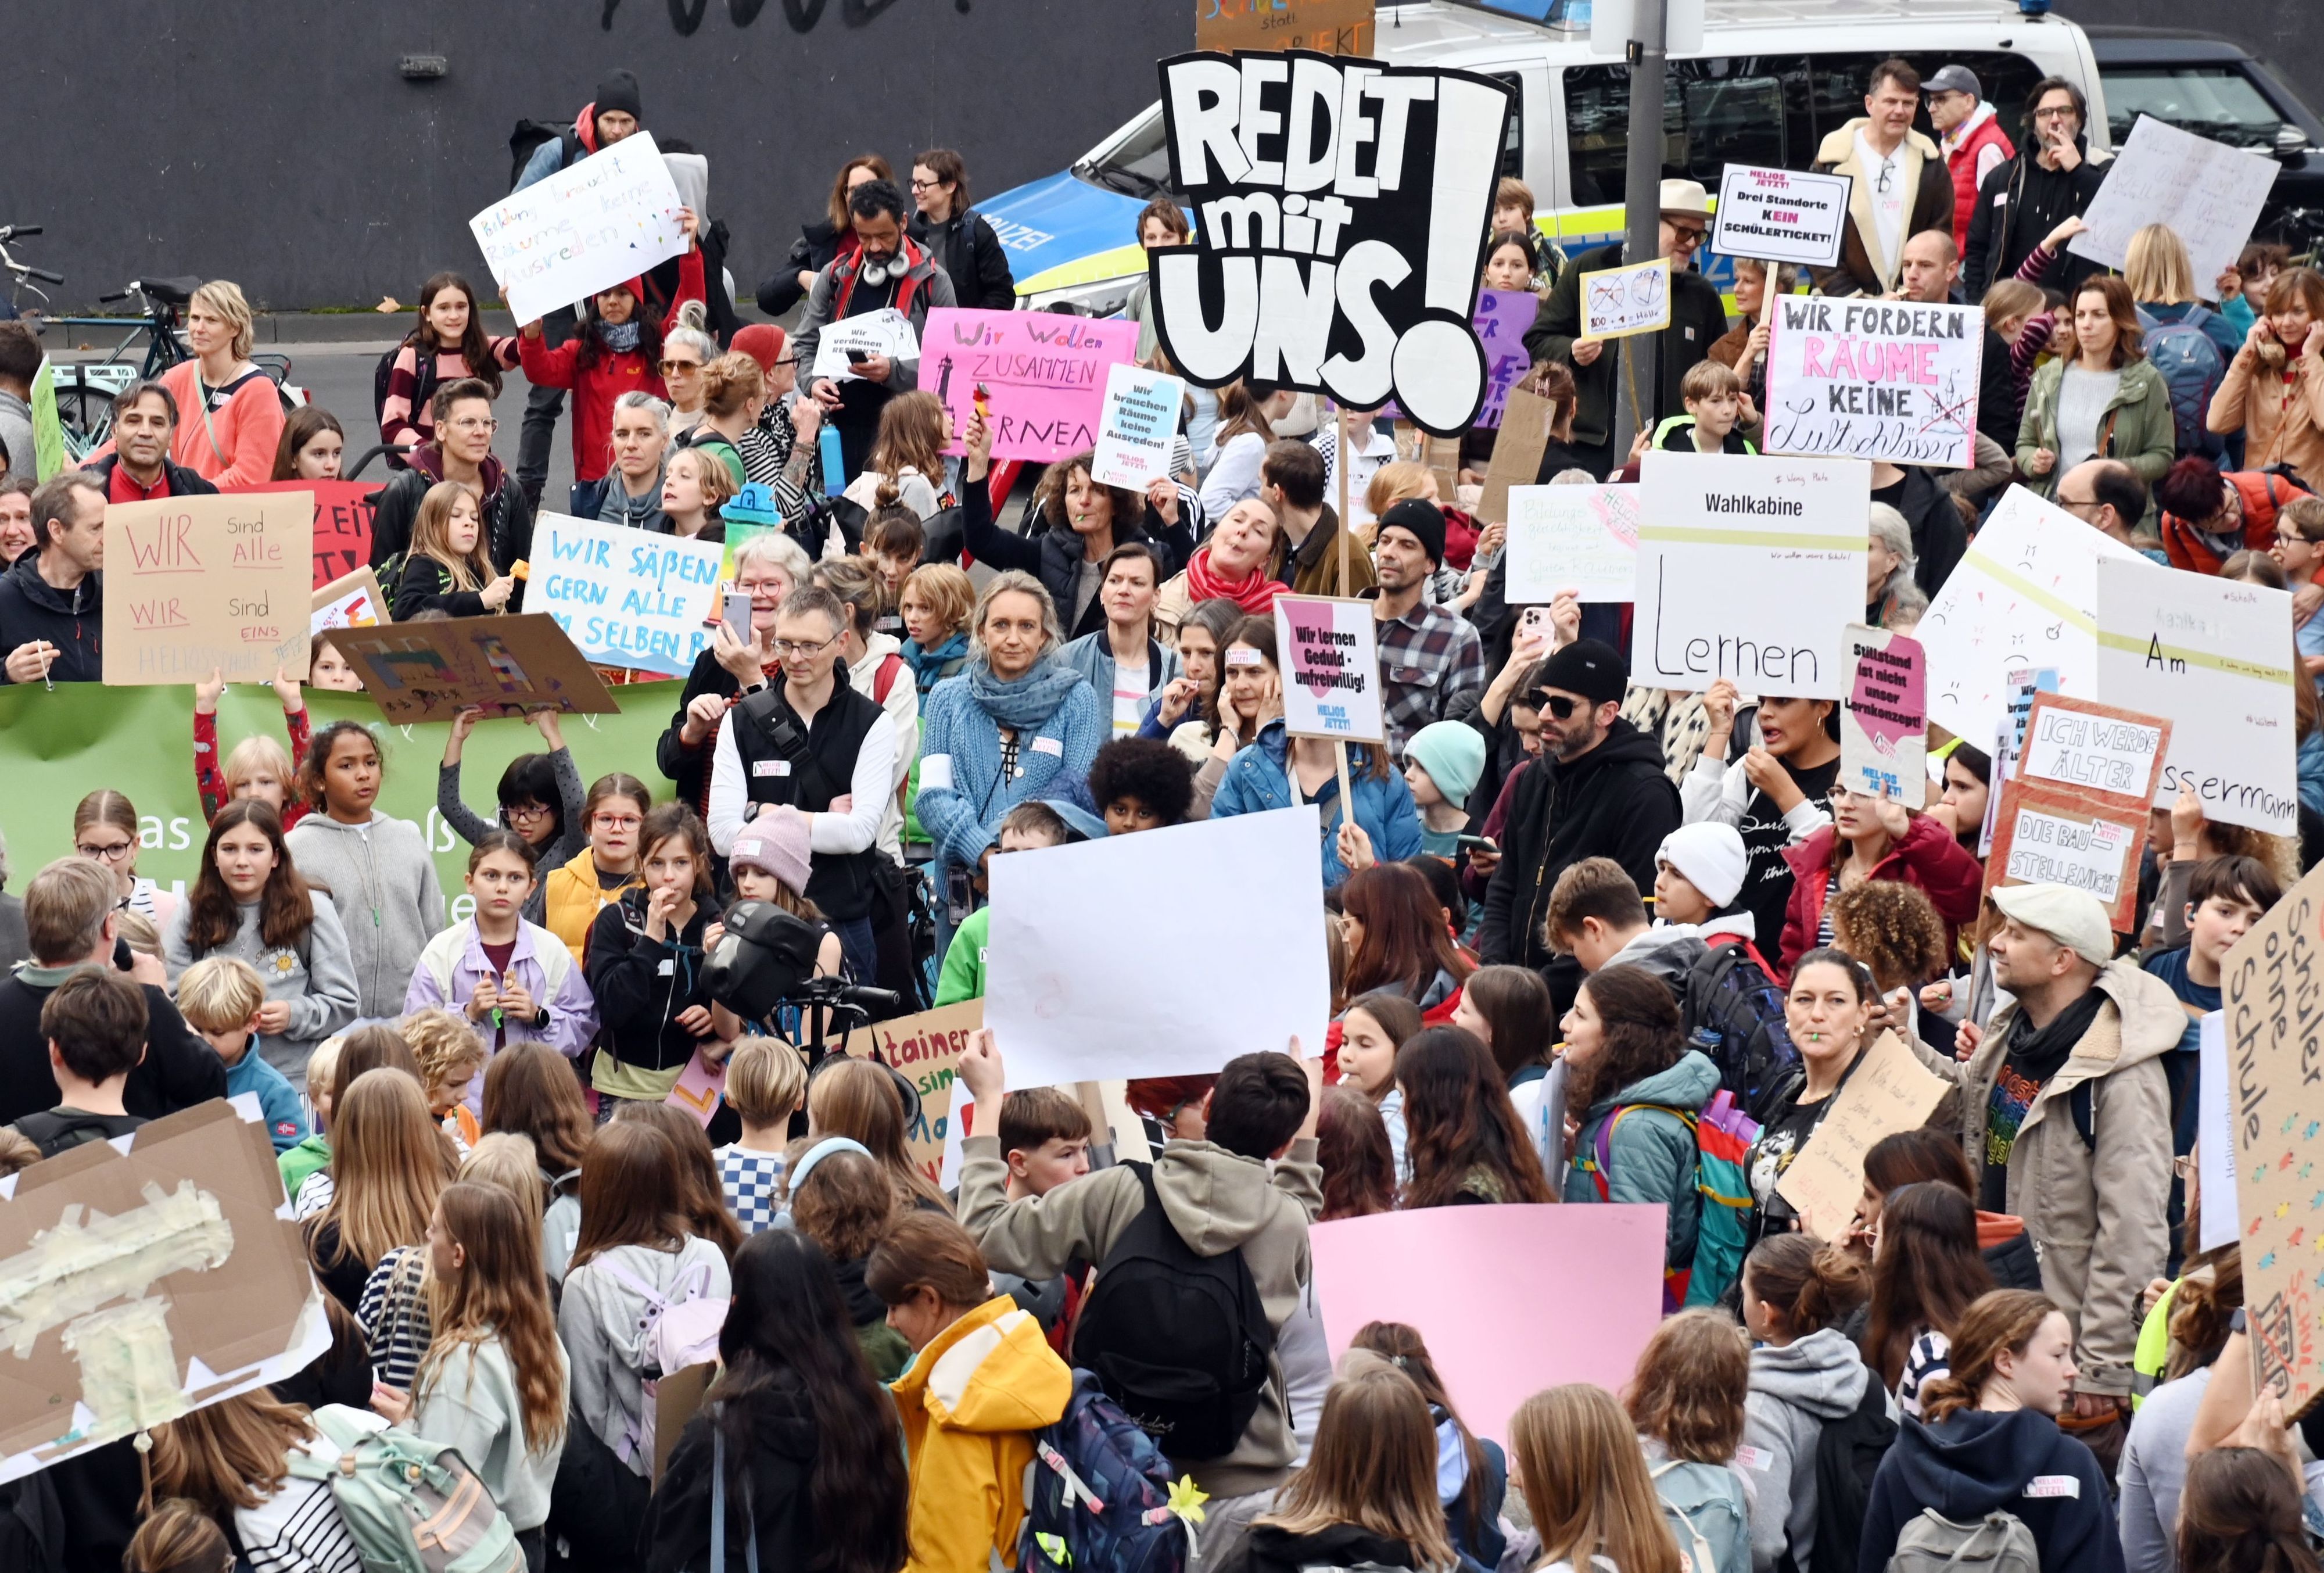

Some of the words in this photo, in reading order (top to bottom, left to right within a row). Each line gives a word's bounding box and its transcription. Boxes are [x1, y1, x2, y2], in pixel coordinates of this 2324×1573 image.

[1167, 58, 1436, 198] REDET
[1749, 170, 1786, 180] HELIOS
[1755, 179, 1789, 189] JETZT!
[1737, 191, 1763, 203] Drei
[1766, 195, 1828, 210] Standorte
[1202, 192, 1353, 257] mit
[1762, 209, 1799, 224] KEIN
[1724, 223, 1831, 243] SCHÜLERTICKET!
[953, 321, 1004, 346] Wir
[1844, 306, 1964, 339] FORDERN
[833, 338, 883, 348] verdienen
[971, 353, 1097, 384] ZUSAMMEN
[1802, 332, 1939, 386] RÄUME
[1113, 392, 1168, 413] brauchen
[1133, 385, 1153, 396] Wir
[1118, 407, 1157, 423] Räume
[1106, 429, 1165, 450] Ausreden!
[1120, 420, 1152, 435] keine
[1770, 397, 1963, 462] Luftschlösser
[1116, 453, 1145, 464] HELIOS
[1120, 460, 1148, 472] JETZT!
[1705, 493, 1803, 517] Wahlkabine
[125, 514, 201, 569] WIR
[552, 530, 611, 569] WIR
[546, 574, 609, 605] GERN
[620, 589, 687, 618] ALLE
[130, 597, 188, 625] WIR
[1655, 554, 1818, 684] Lernen
[241, 626, 279, 639] EINS
[584, 616, 681, 659] SELBEN
[1295, 626, 1316, 643] Wir
[1318, 628, 1356, 647] lernen
[1304, 648, 1345, 667] Geduld
[1853, 643, 1912, 670] Stillstand
[2146, 632, 2186, 675] Am
[1295, 669, 1365, 693] unfreiwillig!
[1876, 669, 1907, 688] nicht
[1864, 686, 1900, 705] unser
[1317, 704, 1346, 718] HELIOS
[1844, 697, 1921, 729] Lernkonzept!
[1324, 718, 1351, 730] JETZT!
[2040, 715, 2088, 747] ICH
[2092, 722, 2160, 755] WERDE
[1862, 766, 1898, 784] HELIOS
[2050, 748, 2134, 790] ÄLTER
[1868, 780, 1902, 798] JEZT!
[2156, 765, 2296, 820] ssermann
[139, 816, 191, 851] as
[2018, 814, 2054, 843] DIE
[2265, 930, 2287, 1051] ohne
[2287, 896, 2324, 1087] Schüler
[2230, 955, 2268, 1152] Schule
[2035, 1485, 2065, 1496] JETZT!
